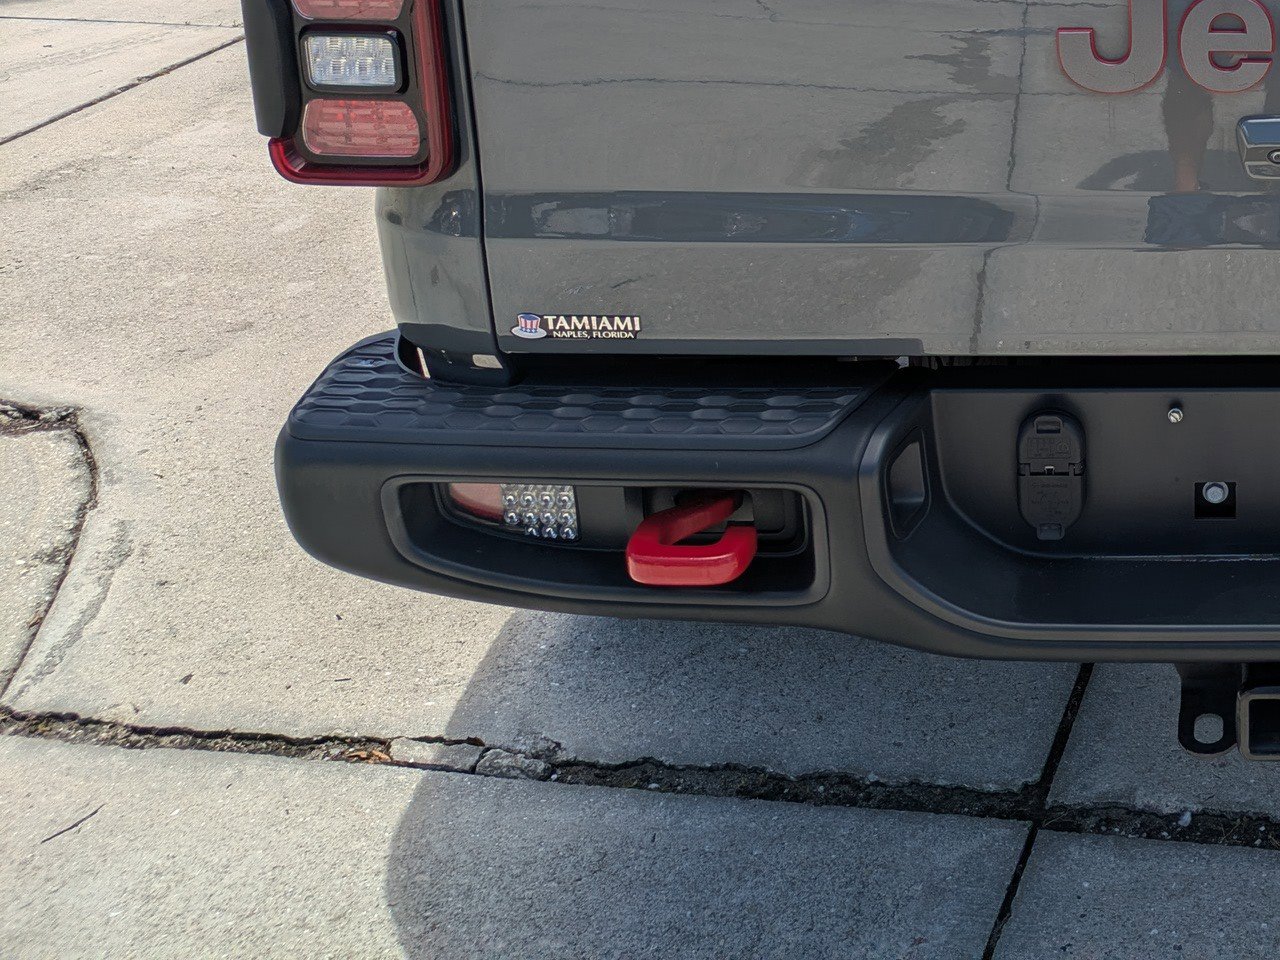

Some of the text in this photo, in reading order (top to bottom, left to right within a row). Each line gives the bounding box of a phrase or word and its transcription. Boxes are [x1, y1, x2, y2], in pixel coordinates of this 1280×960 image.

[543, 315, 641, 331] TAMIAMI
[553, 331, 635, 340] NAPLES, FLORIDA
